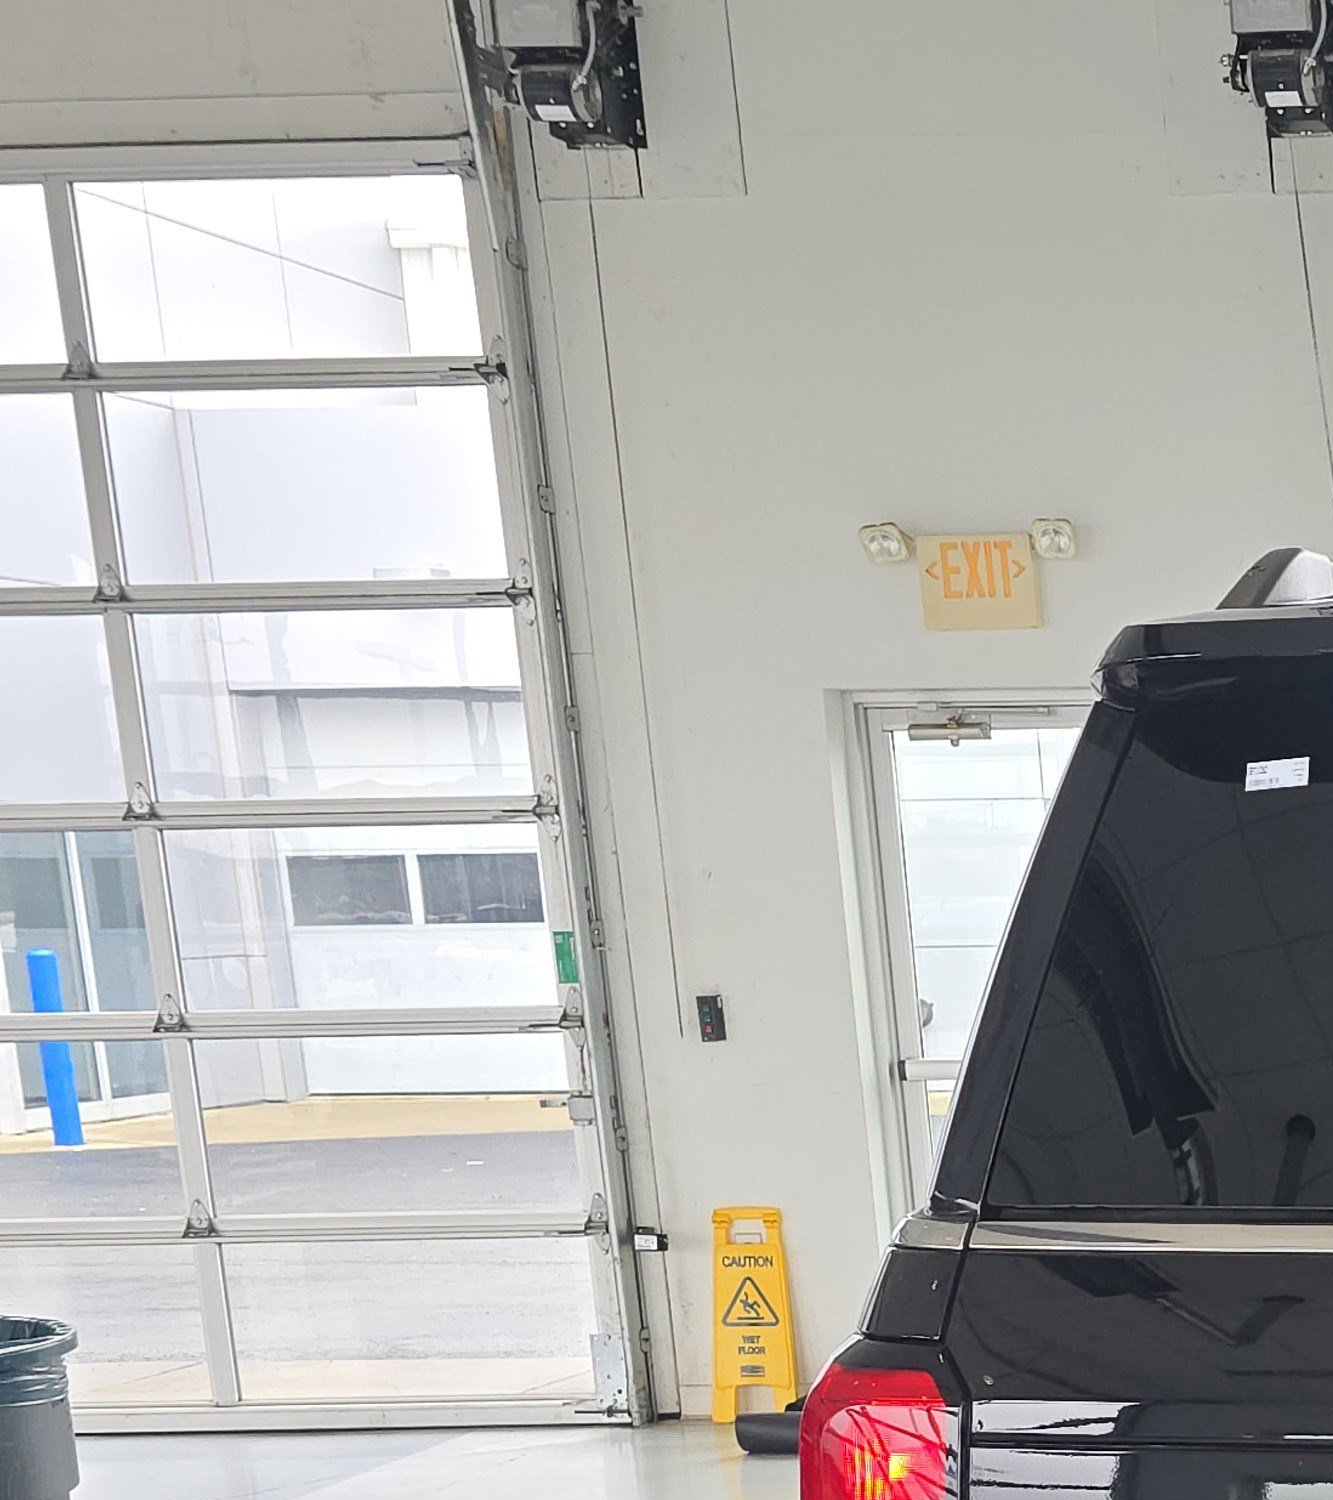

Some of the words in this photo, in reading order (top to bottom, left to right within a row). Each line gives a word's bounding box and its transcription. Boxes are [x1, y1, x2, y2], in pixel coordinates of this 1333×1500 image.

[939, 540, 1012, 599] EXIT
[722, 1256, 773, 1268] CAUTION
[742, 1335, 761, 1344] WET
[738, 1346, 766, 1355] FLOOR
